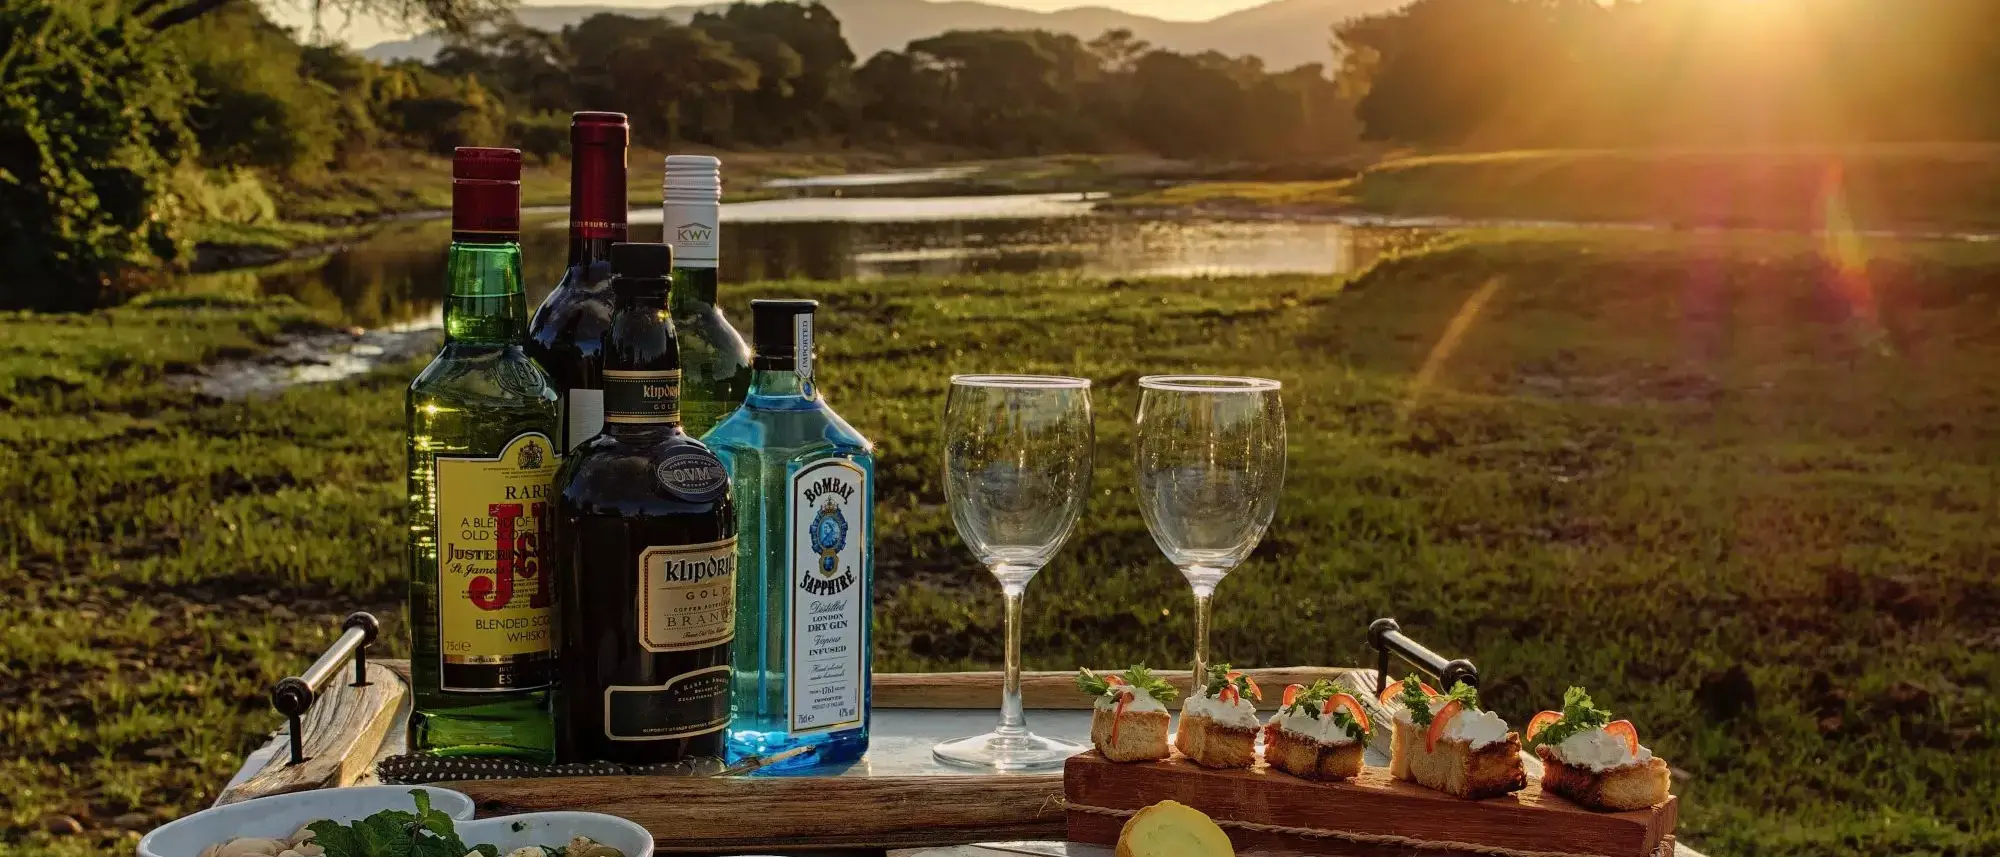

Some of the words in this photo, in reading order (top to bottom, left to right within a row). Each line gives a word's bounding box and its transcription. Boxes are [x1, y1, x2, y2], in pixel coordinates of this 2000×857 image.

[678, 229, 711, 240] KWV
[673, 467, 712, 482] OVM
[803, 477, 854, 507] BOMBAY
[461, 518, 470, 527] A
[474, 518, 512, 527] BLEND
[516, 517, 531, 527] OF
[462, 530, 489, 540] OLD
[800, 565, 855, 596] SAPPHIRE
[686, 586, 728, 600] GOLD
[809, 600, 847, 614] Distilled
[476, 617, 528, 630] BLENDED
[813, 614, 844, 622] LONDON
[808, 623, 827, 632] DRY
[829, 620, 848, 630] GIN
[507, 629, 548, 643] WHISKY
[814, 635, 841, 647] Vapour
[809, 646, 846, 655] INFUSED
[822, 686, 834, 695] 1761
